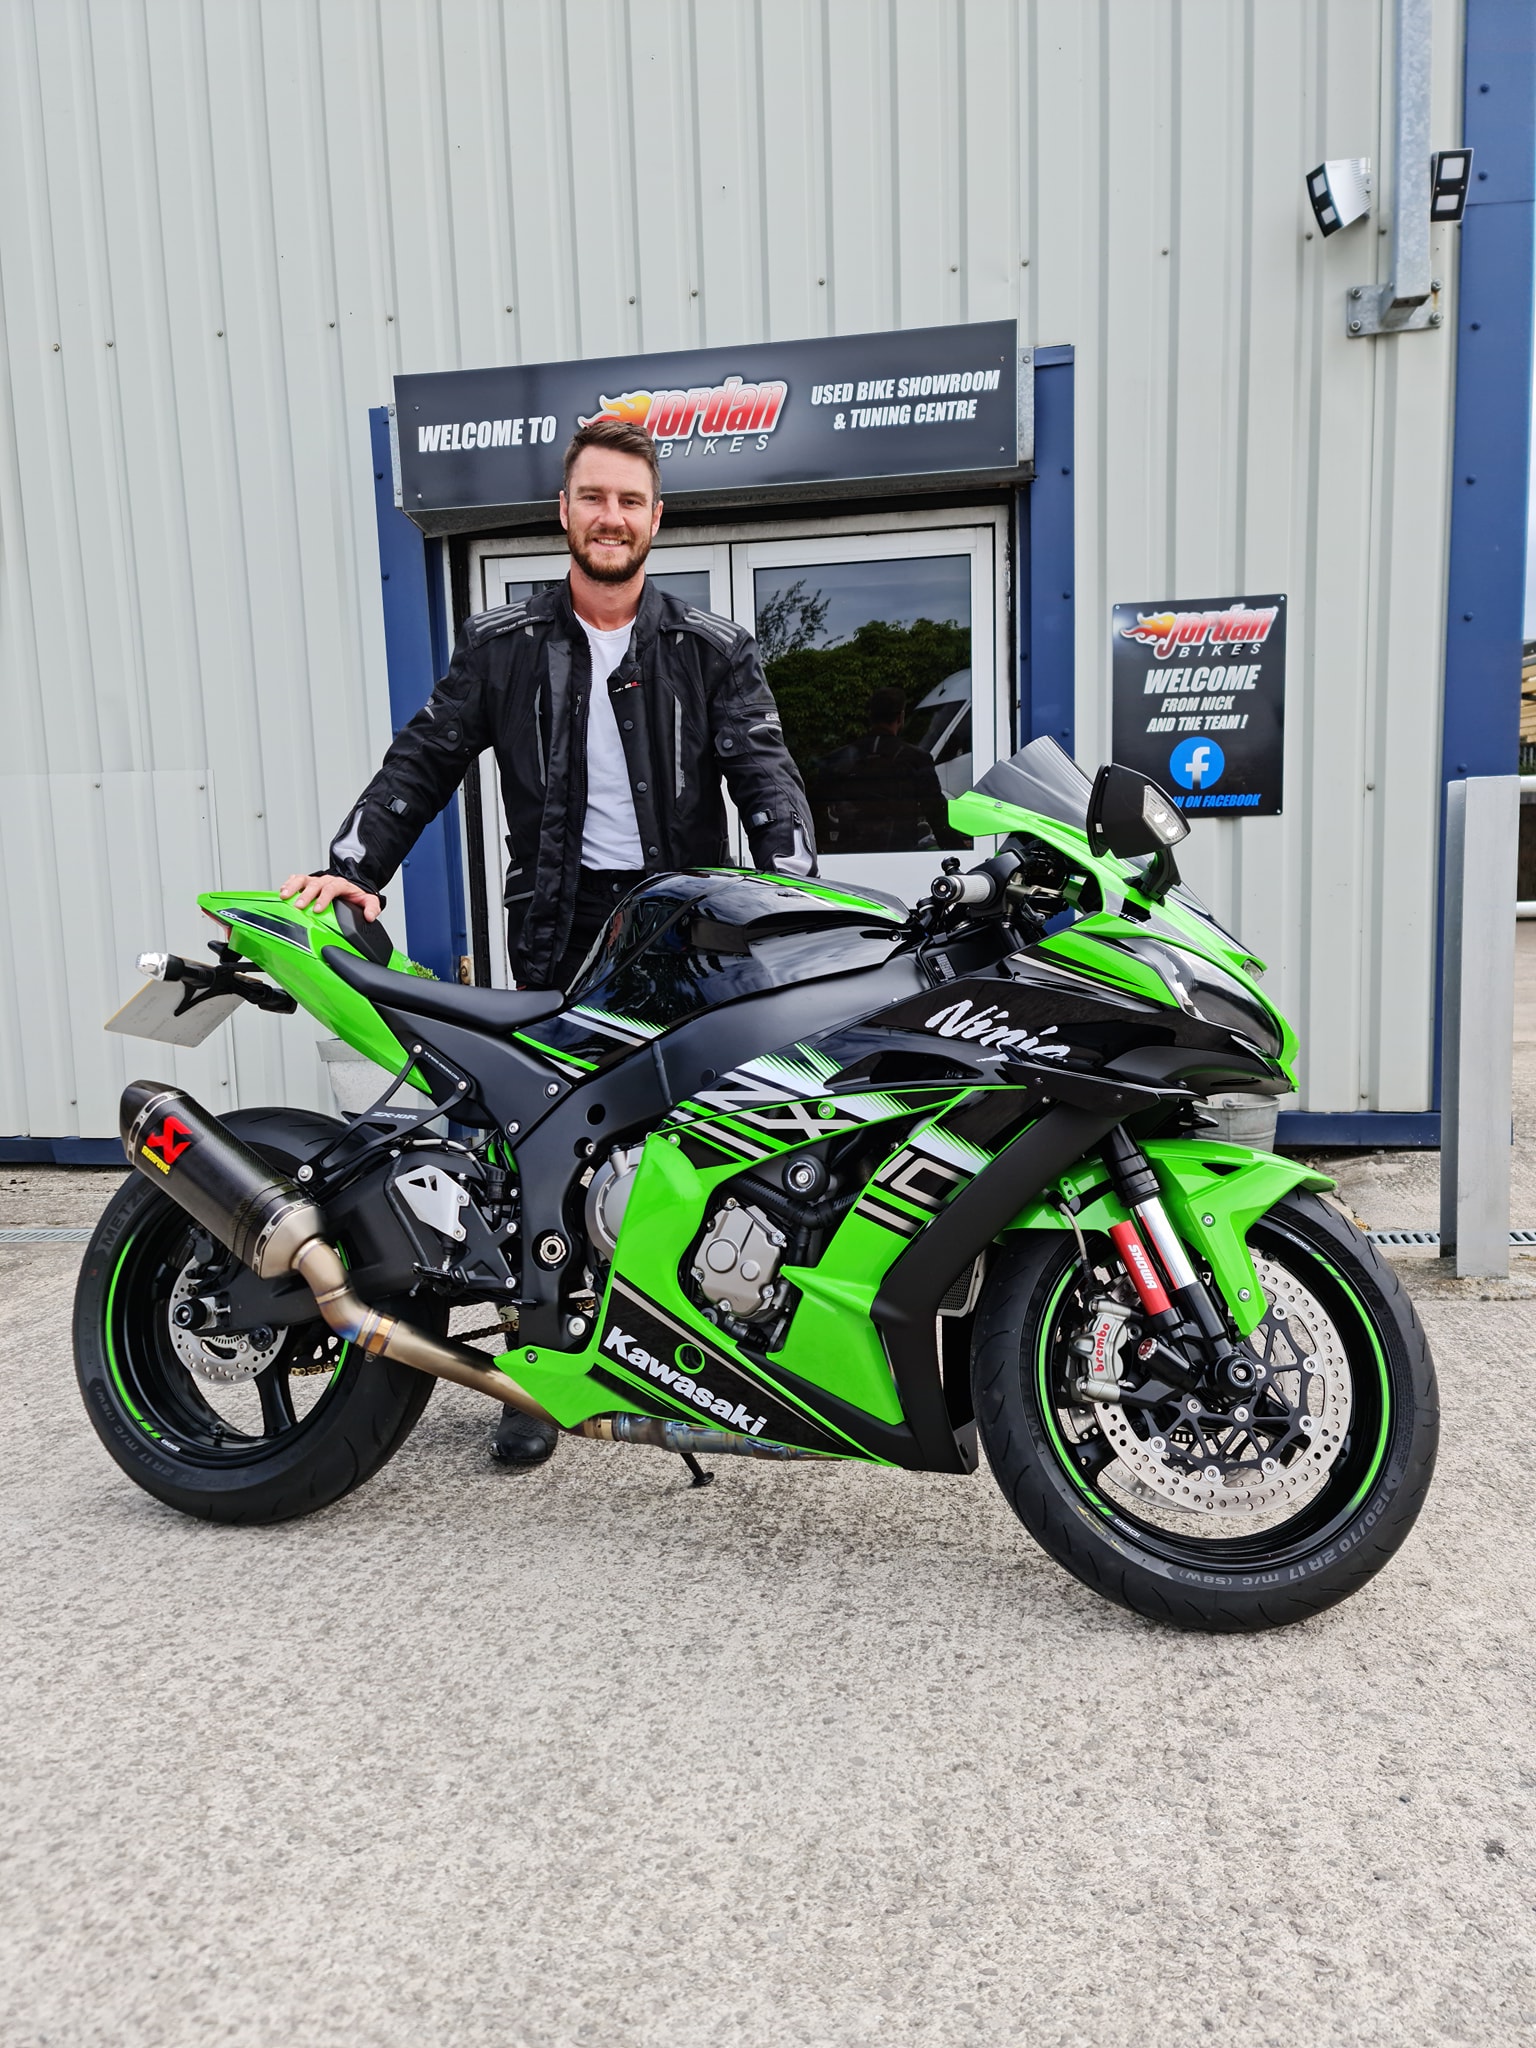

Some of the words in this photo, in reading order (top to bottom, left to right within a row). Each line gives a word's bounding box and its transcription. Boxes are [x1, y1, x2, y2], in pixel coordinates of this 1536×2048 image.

[810, 383, 854, 405] USED
[856, 379, 896, 401] BIKE
[897, 369, 1001, 398] SHOWROOM
[833, 413, 846, 430] &
[850, 404, 912, 429] TUNING
[913, 399, 978, 423] CENTRE
[418, 418, 524, 452] WELCOME
[528, 415, 557, 444] TO
[659, 434, 769, 459] BIKES
[1178, 642, 1263, 658] BIKES
[1143, 664, 1262, 695] WELCOME
[1160, 697, 1200, 713] FROM
[1200, 695, 1236, 711] NICK
[1146, 717, 1176, 733] AND
[1177, 716, 1203, 731] THE
[1203, 714, 1241, 730] TEAM
[1185, 795, 1202, 808] ON
[1202, 793, 1261, 808] FACEBOOK
[925, 999, 1071, 1063] Ninja
[1127, 1244, 1158, 1290] SHOWA
[1094, 1322, 1111, 1373] brembo
[603, 1325, 768, 1436] Kawasaki
